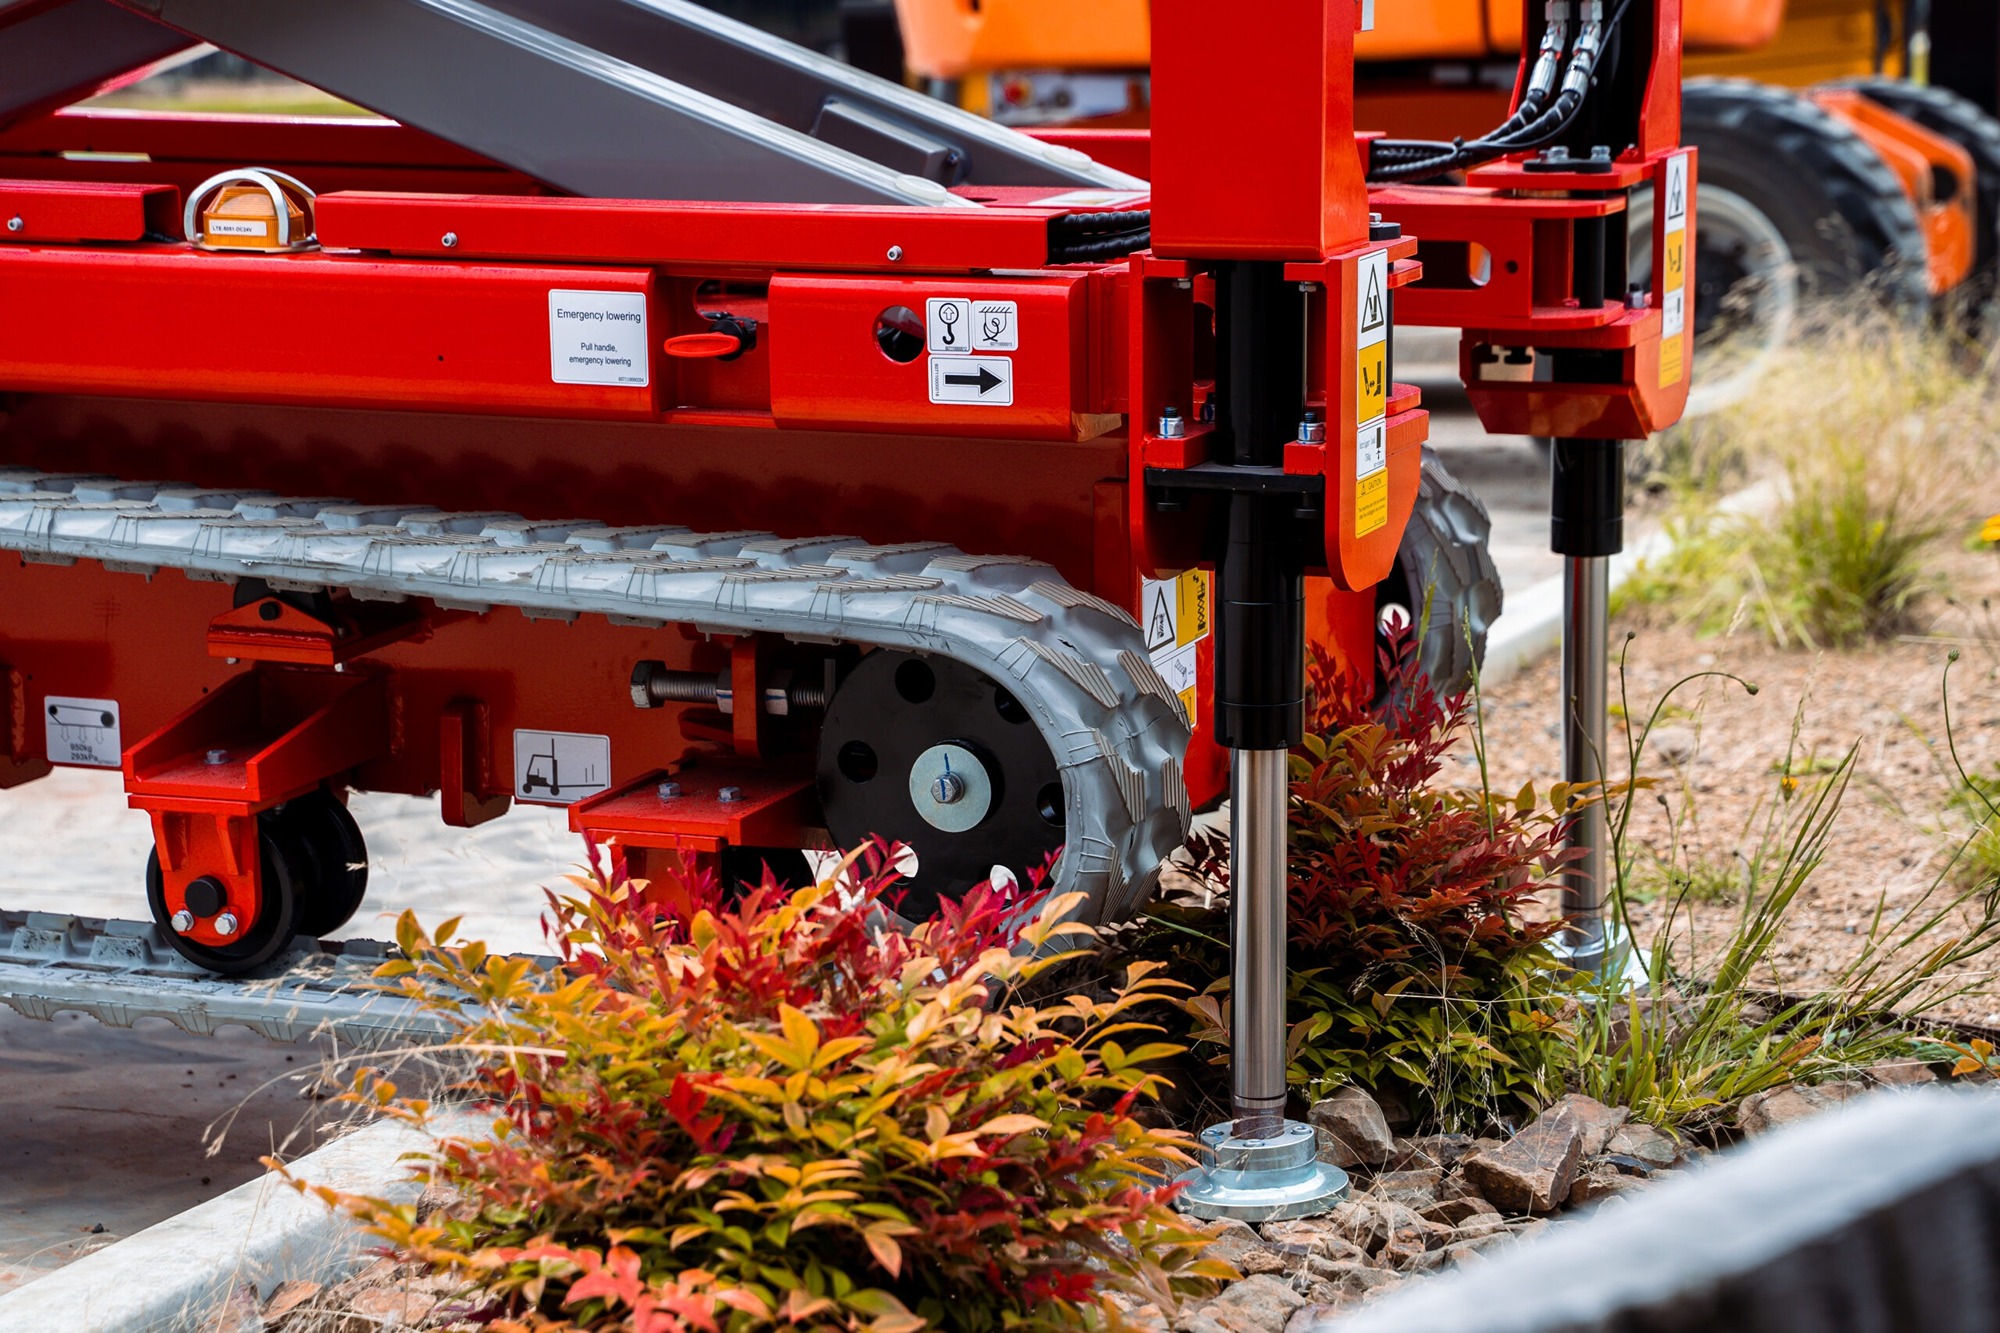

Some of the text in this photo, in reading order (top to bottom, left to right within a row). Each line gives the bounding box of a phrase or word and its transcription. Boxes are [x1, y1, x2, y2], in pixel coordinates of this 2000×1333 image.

[557, 308, 641, 324] Emergency lowering
[580, 342, 617, 353] Pull handle,
[569, 356, 632, 367] emergency lowering
